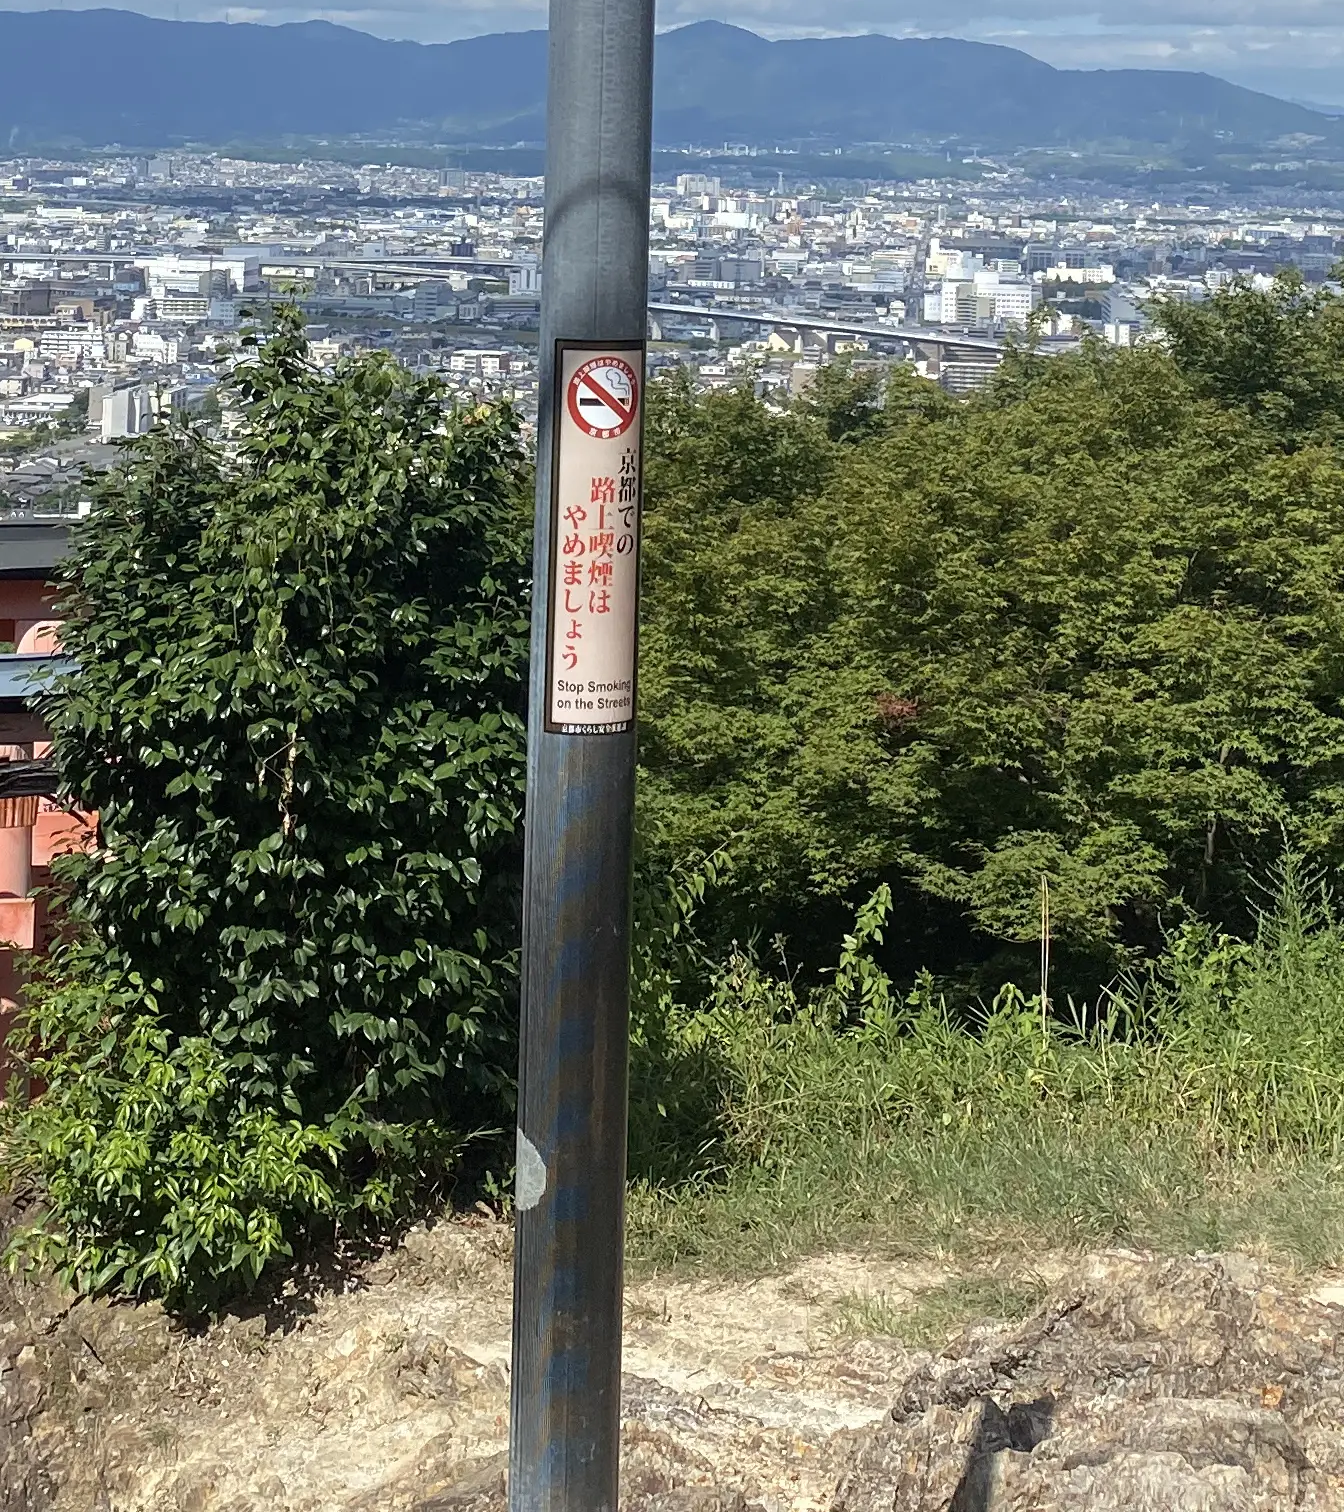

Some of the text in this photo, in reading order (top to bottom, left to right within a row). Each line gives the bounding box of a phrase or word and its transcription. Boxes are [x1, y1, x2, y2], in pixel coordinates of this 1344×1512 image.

[589, 427, 621, 439] 京都市
[616, 447, 636, 556] 京都での
[587, 476, 616, 615] 路上喫煙は
[561, 504, 588, 671] やめましょう
[557, 678, 631, 695] Stop Smoking
[557, 696, 631, 710] on the Streets
